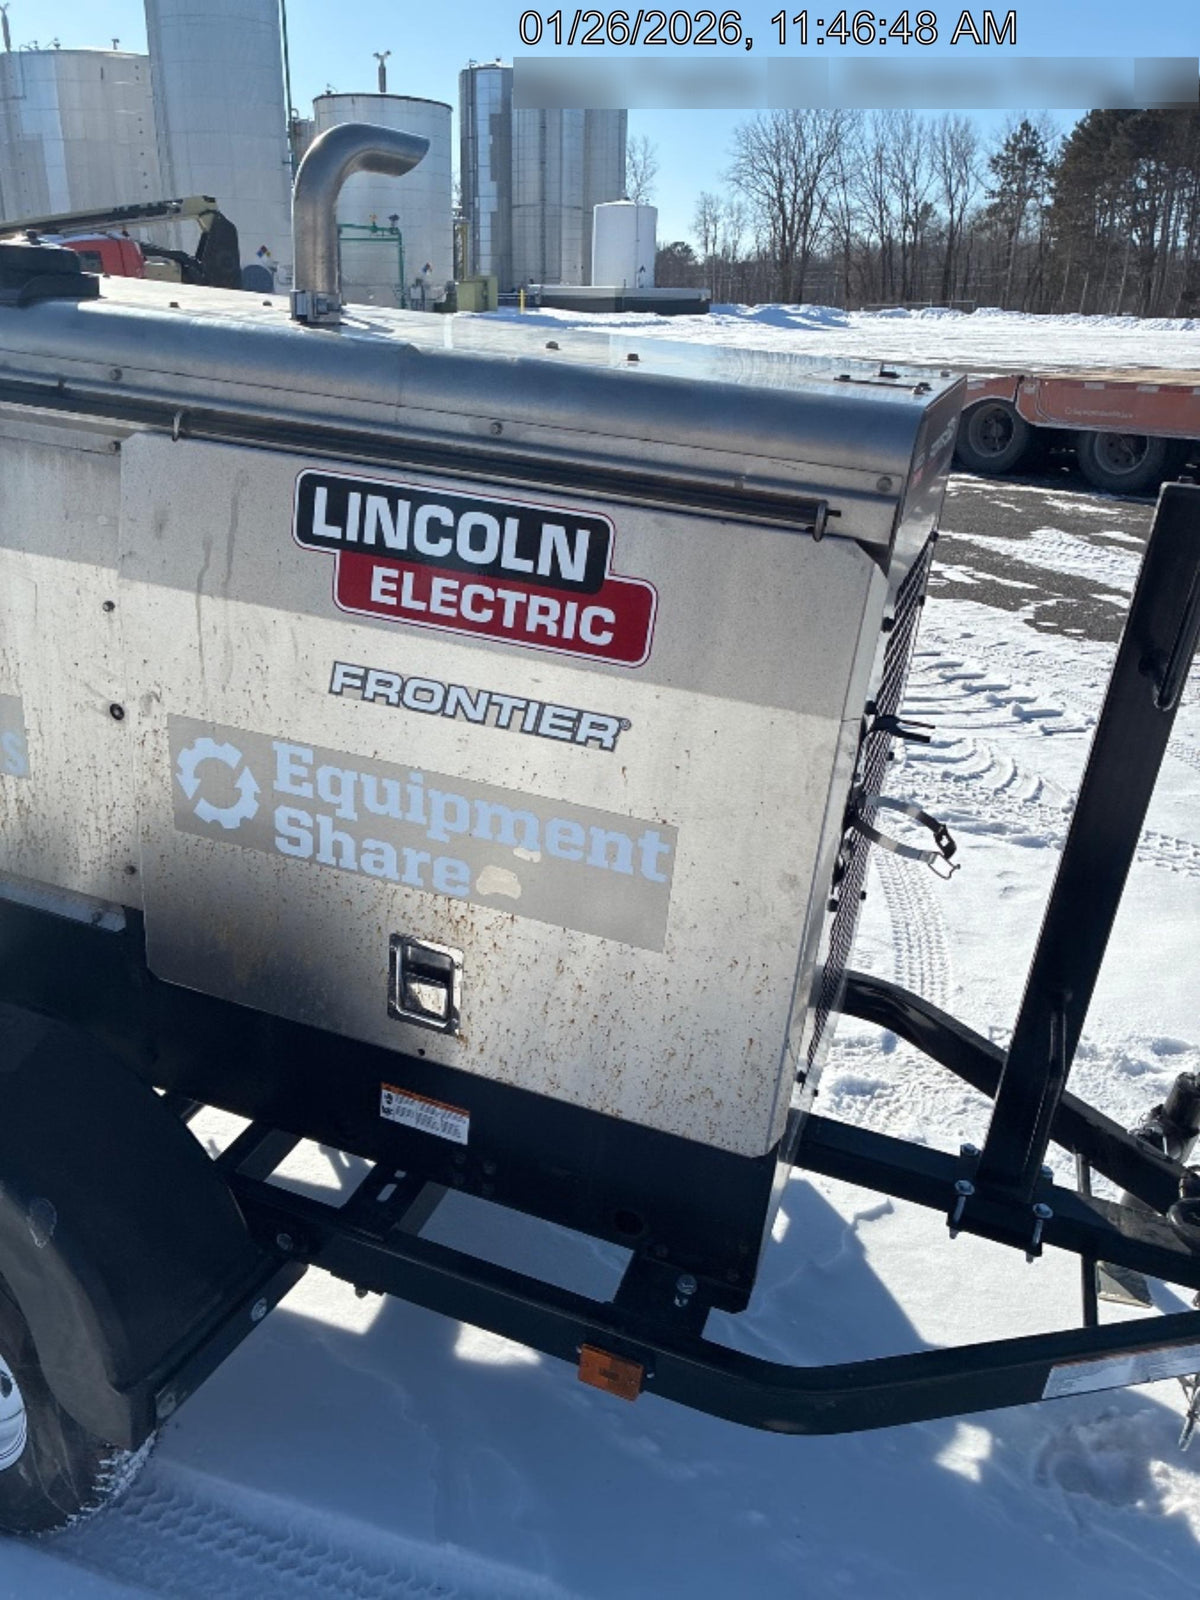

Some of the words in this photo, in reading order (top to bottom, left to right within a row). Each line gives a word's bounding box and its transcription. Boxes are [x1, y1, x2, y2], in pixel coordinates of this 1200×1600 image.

[311, 486, 591, 582] LINCOLN
[370, 565, 617, 647] ELECTRIC
[271, 739, 671, 883] Equipment
[273, 805, 471, 898] Share
